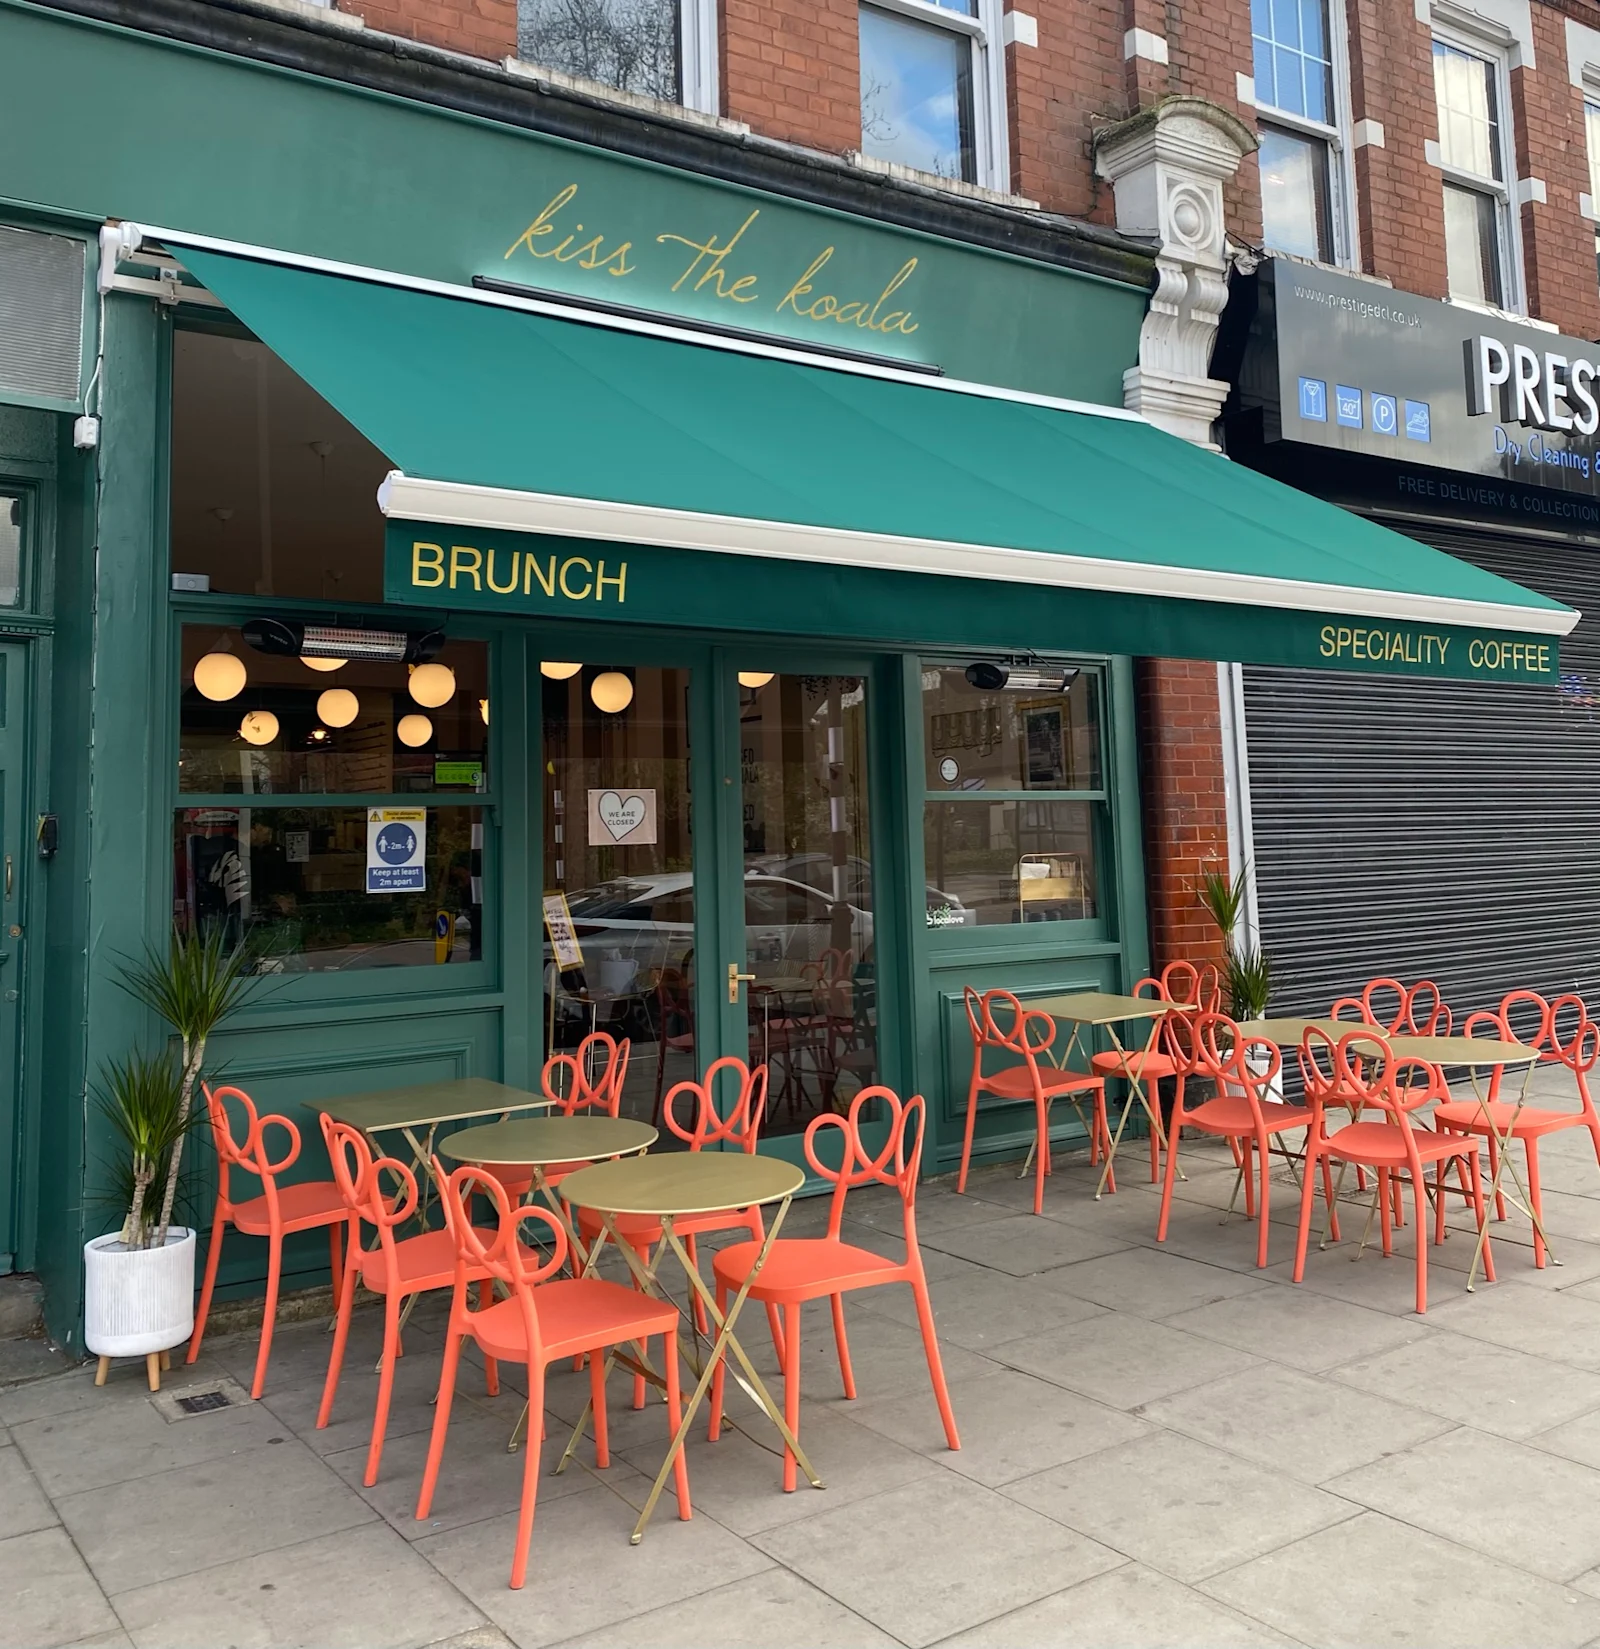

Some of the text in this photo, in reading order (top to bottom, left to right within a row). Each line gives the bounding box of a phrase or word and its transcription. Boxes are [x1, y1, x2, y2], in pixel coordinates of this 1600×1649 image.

[504, 184, 636, 276] kiss
[776, 246, 919, 334] koala
[1294, 284, 1422, 328] www.prestigedcl.co.uk
[1479, 335, 1600, 435] PRES
[1493, 425, 1522, 465] Dry
[1527, 433, 1590, 478] Cleaning
[1398, 475, 1600, 522] FREE DELIVERY & COLLECTION
[411, 541, 628, 603] BRUNCH
[1319, 625, 1551, 672] SPECIALITY COFFEE
[372, 868, 419, 877] Keep at least
[393, 879, 412, 887] apart
